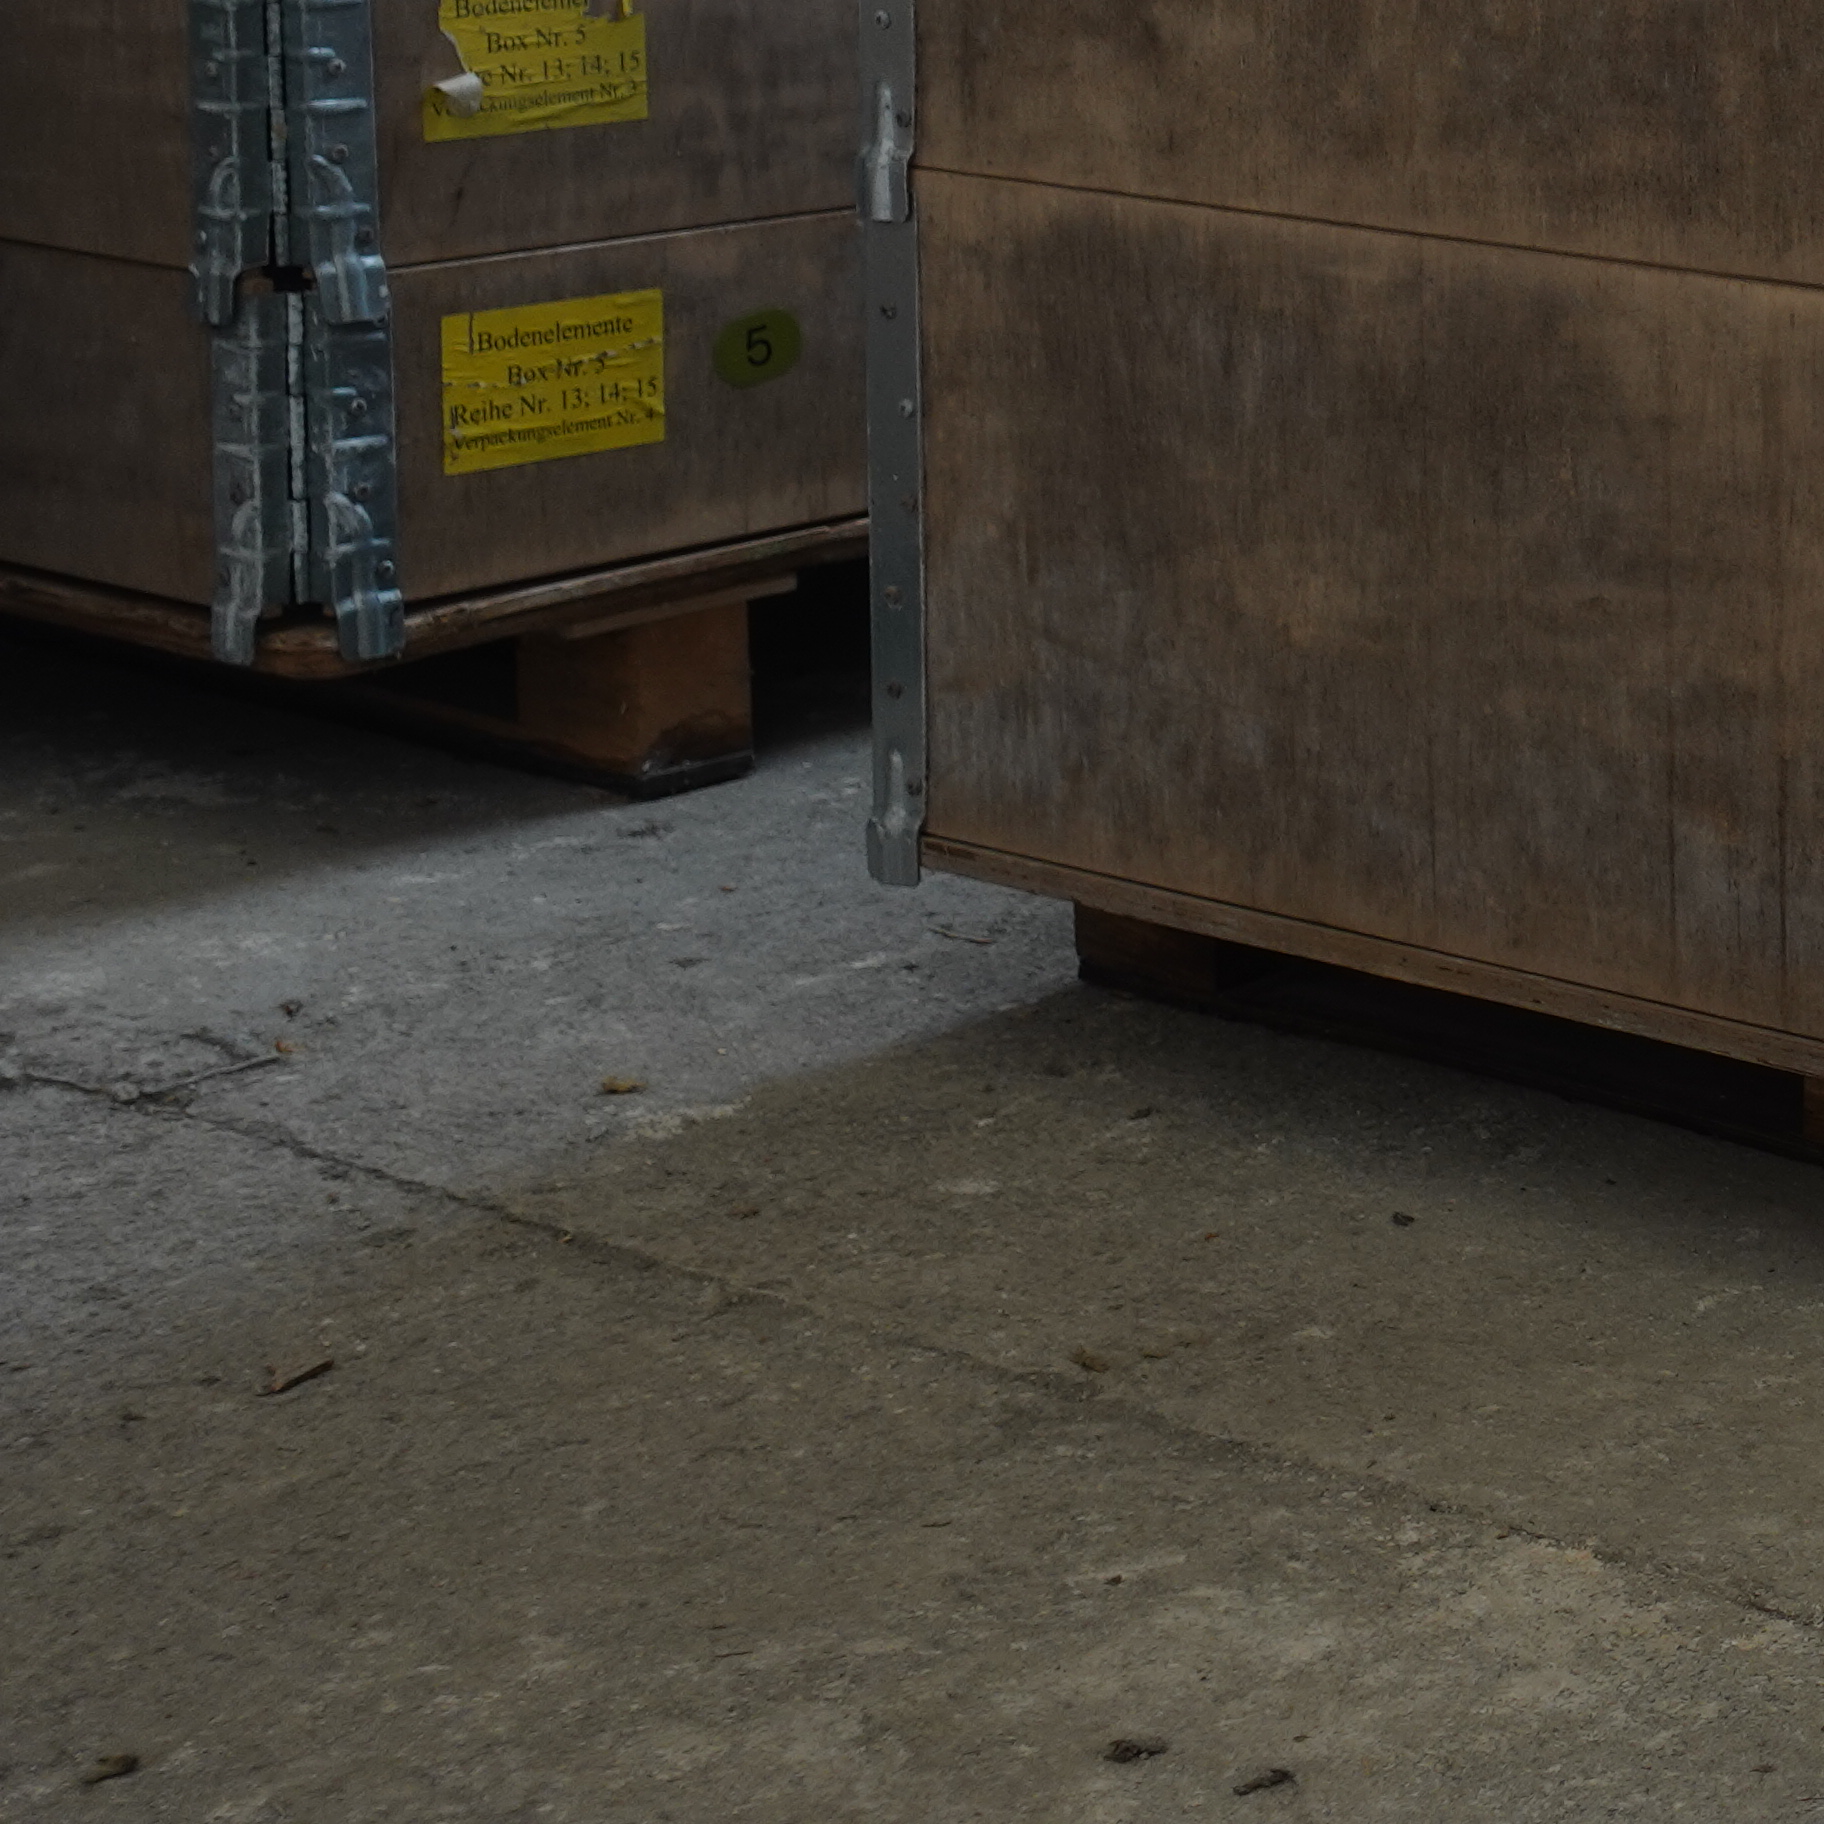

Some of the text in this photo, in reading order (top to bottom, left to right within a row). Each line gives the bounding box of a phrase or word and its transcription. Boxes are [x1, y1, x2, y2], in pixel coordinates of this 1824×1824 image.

[486, 26, 586, 54] Box Nr. 5
[500, 64, 531, 85] Nr.
[619, 51, 640, 72] 15
[477, 316, 633, 352] Bodenelemente
[747, 325, 772, 365] 5
[454, 400, 513, 426] Reihe
[520, 395, 550, 416] Nr.
[561, 387, 590, 410] 13;
[637, 377, 657, 398] 15
